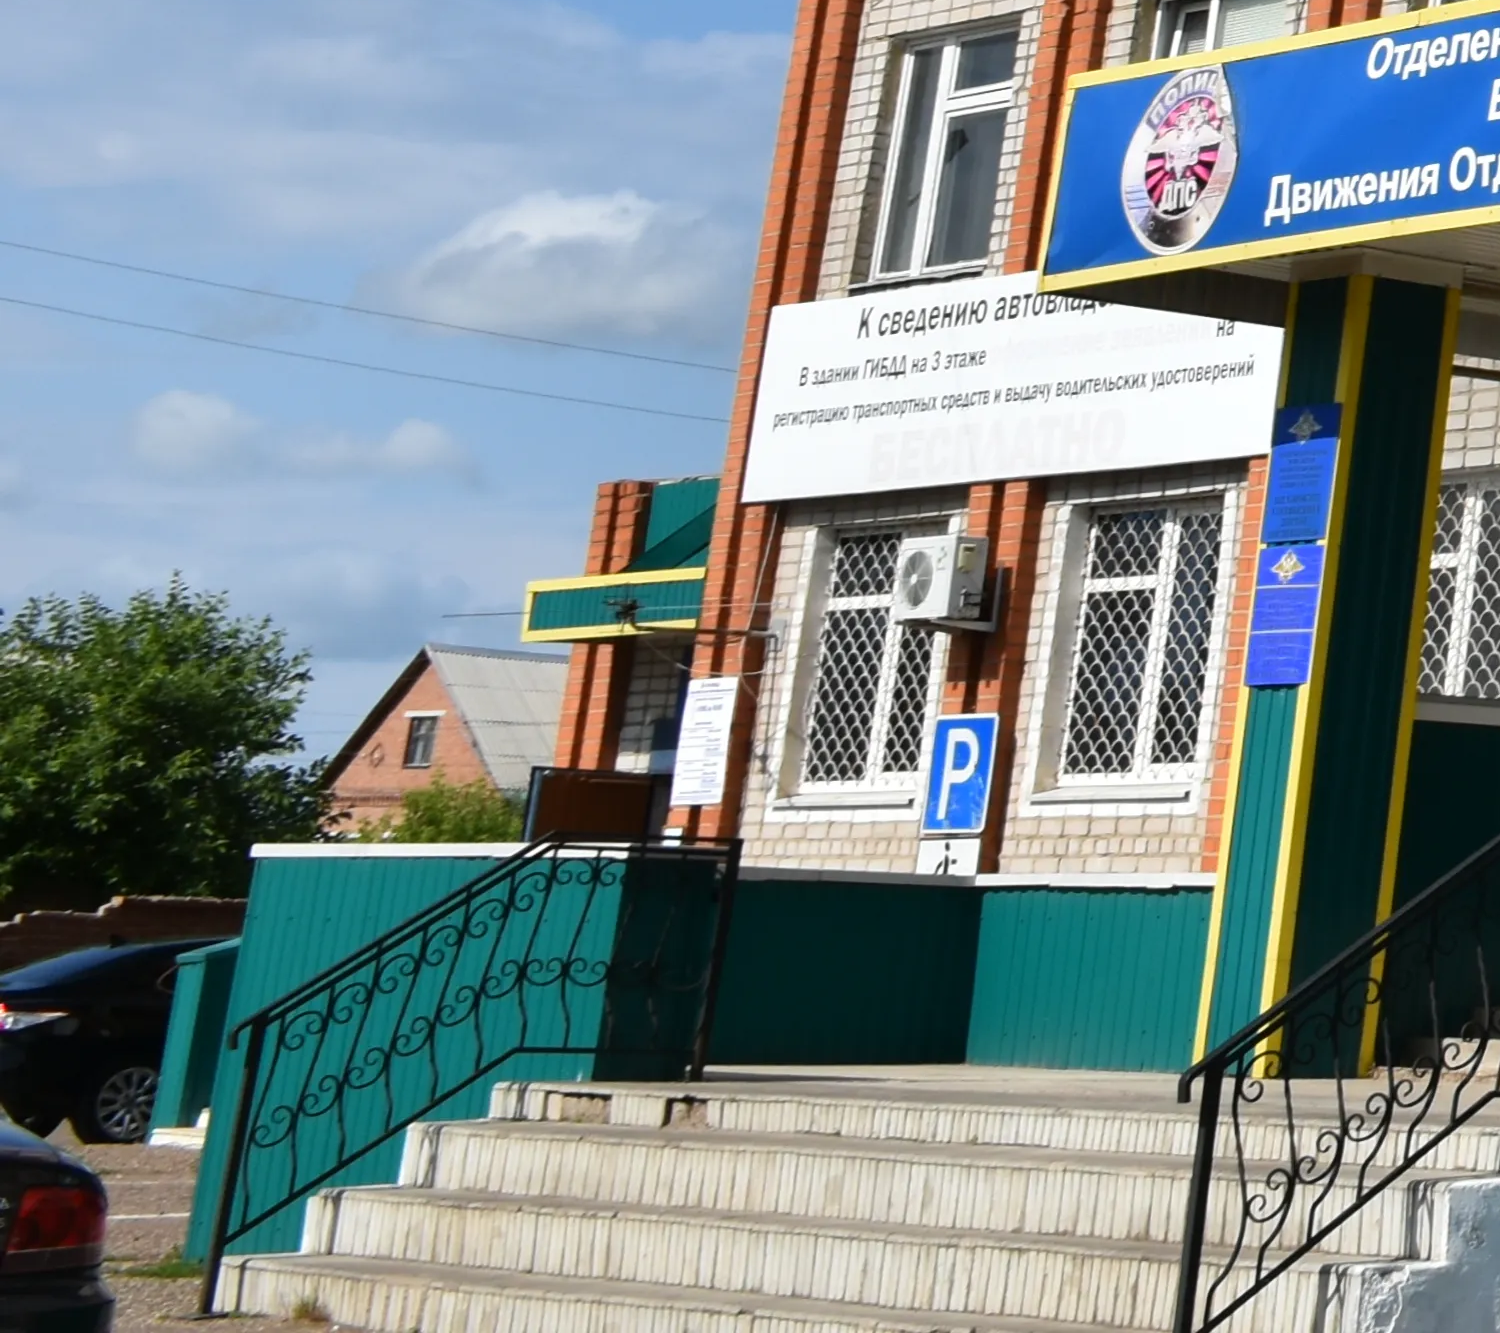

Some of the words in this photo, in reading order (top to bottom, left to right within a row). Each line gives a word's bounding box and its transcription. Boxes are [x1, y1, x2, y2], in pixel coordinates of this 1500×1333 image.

[1160, 178, 1198, 212] ДПС
[1264, 163, 1440, 227] Движения
[857, 307, 874, 339] К
[878, 299, 988, 337] сведению
[799, 366, 809, 387] В
[811, 366, 860, 385] здании
[863, 355, 906, 379] ГИБДД
[911, 357, 928, 373] на
[931, 350, 941, 371] 3
[944, 350, 986, 370] этаже
[1216, 320, 1235, 337] на
[773, 406, 849, 431] регистрацию
[853, 397, 937, 423] транспортных
[941, 390, 990, 413] средств
[993, 389, 1002, 403] и
[1004, 384, 1051, 403] выдачу
[1055, 373, 1147, 397] водительских
[1150, 354, 1254, 392] удостоверений
